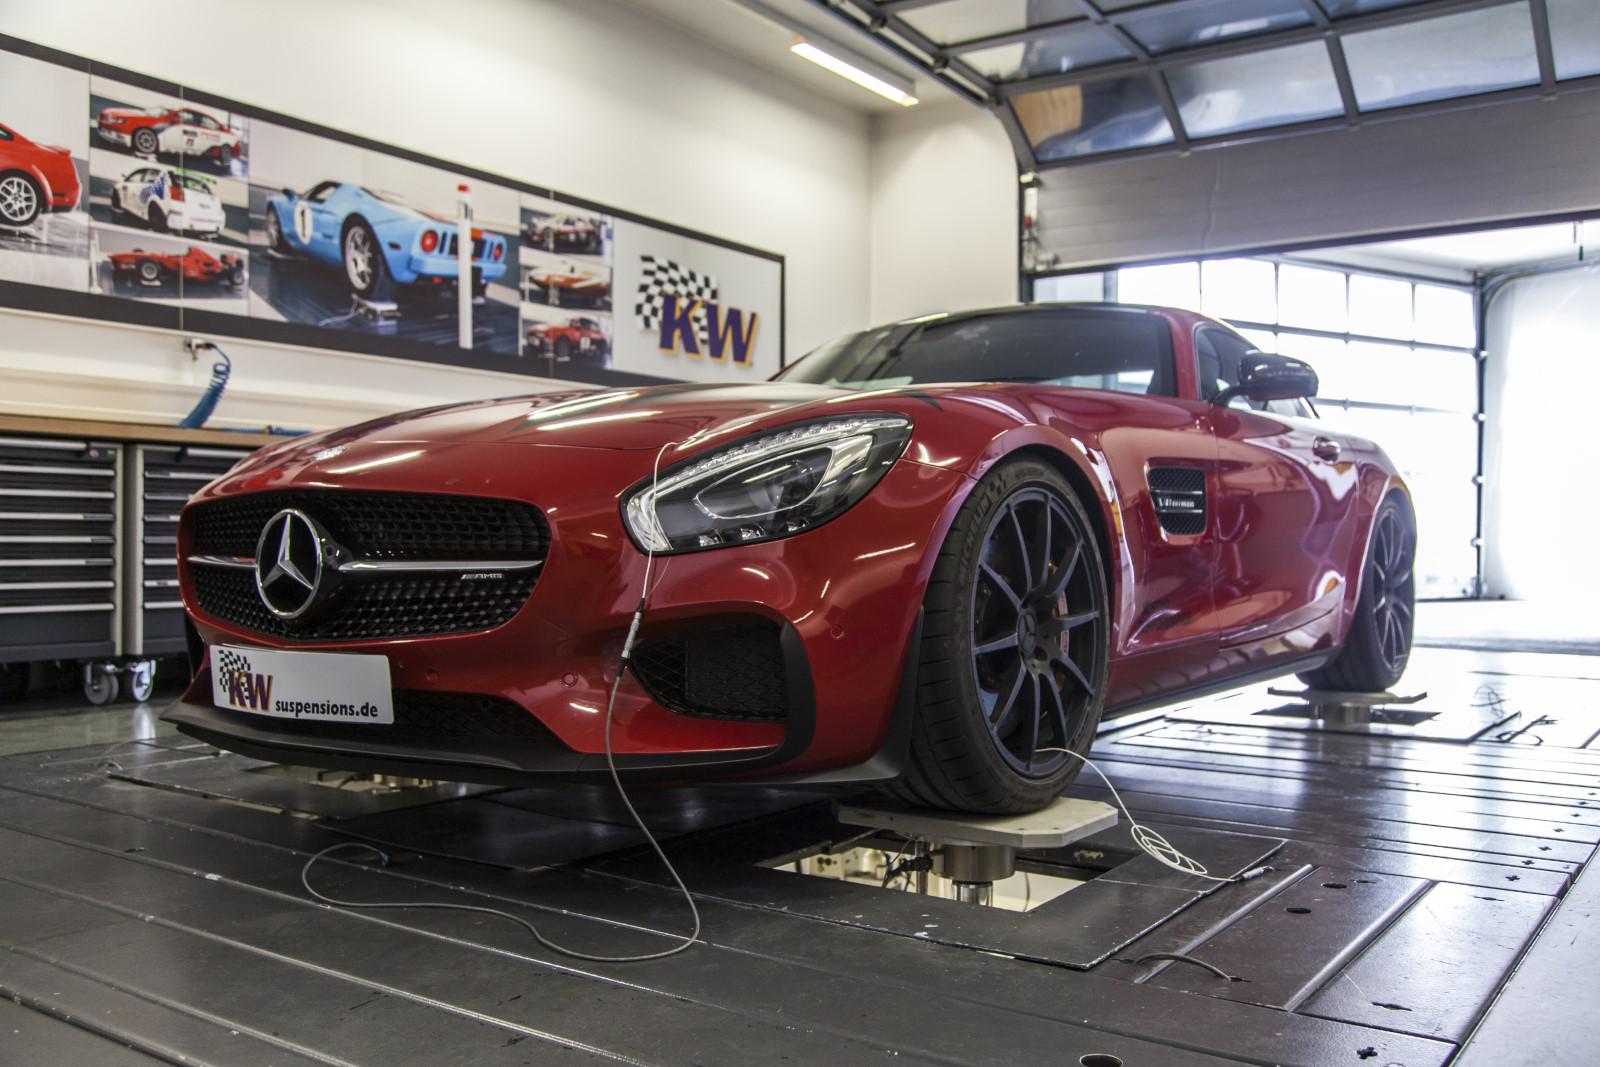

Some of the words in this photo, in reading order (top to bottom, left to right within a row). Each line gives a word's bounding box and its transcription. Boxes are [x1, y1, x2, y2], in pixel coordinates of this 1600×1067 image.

[659, 292, 758, 366] KW
[227, 669, 273, 712] KW
[275, 700, 379, 718] suspensions.de
